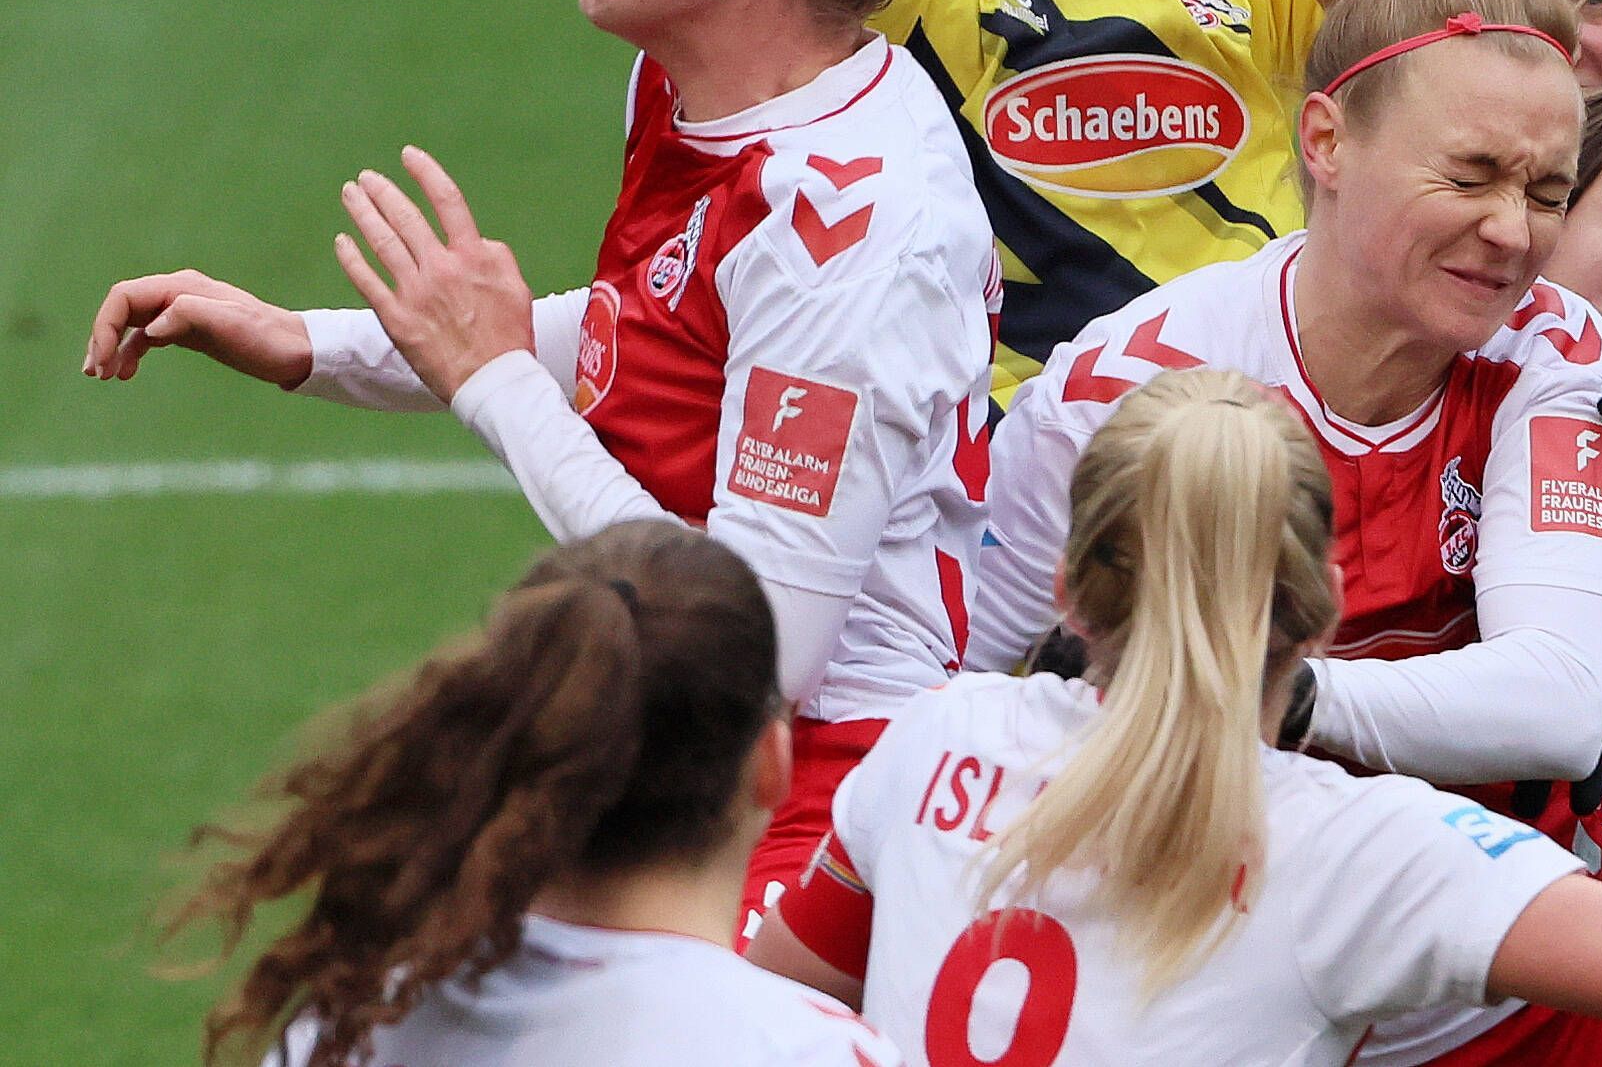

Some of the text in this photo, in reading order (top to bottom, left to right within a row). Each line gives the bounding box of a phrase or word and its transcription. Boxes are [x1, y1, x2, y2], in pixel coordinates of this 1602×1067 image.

[1006, 92, 1221, 142] Schaebens
[738, 453, 794, 481] FRAUEN-
[742, 436, 829, 474] FLYERALARM
[734, 468, 821, 506] BUNDESLIGA
